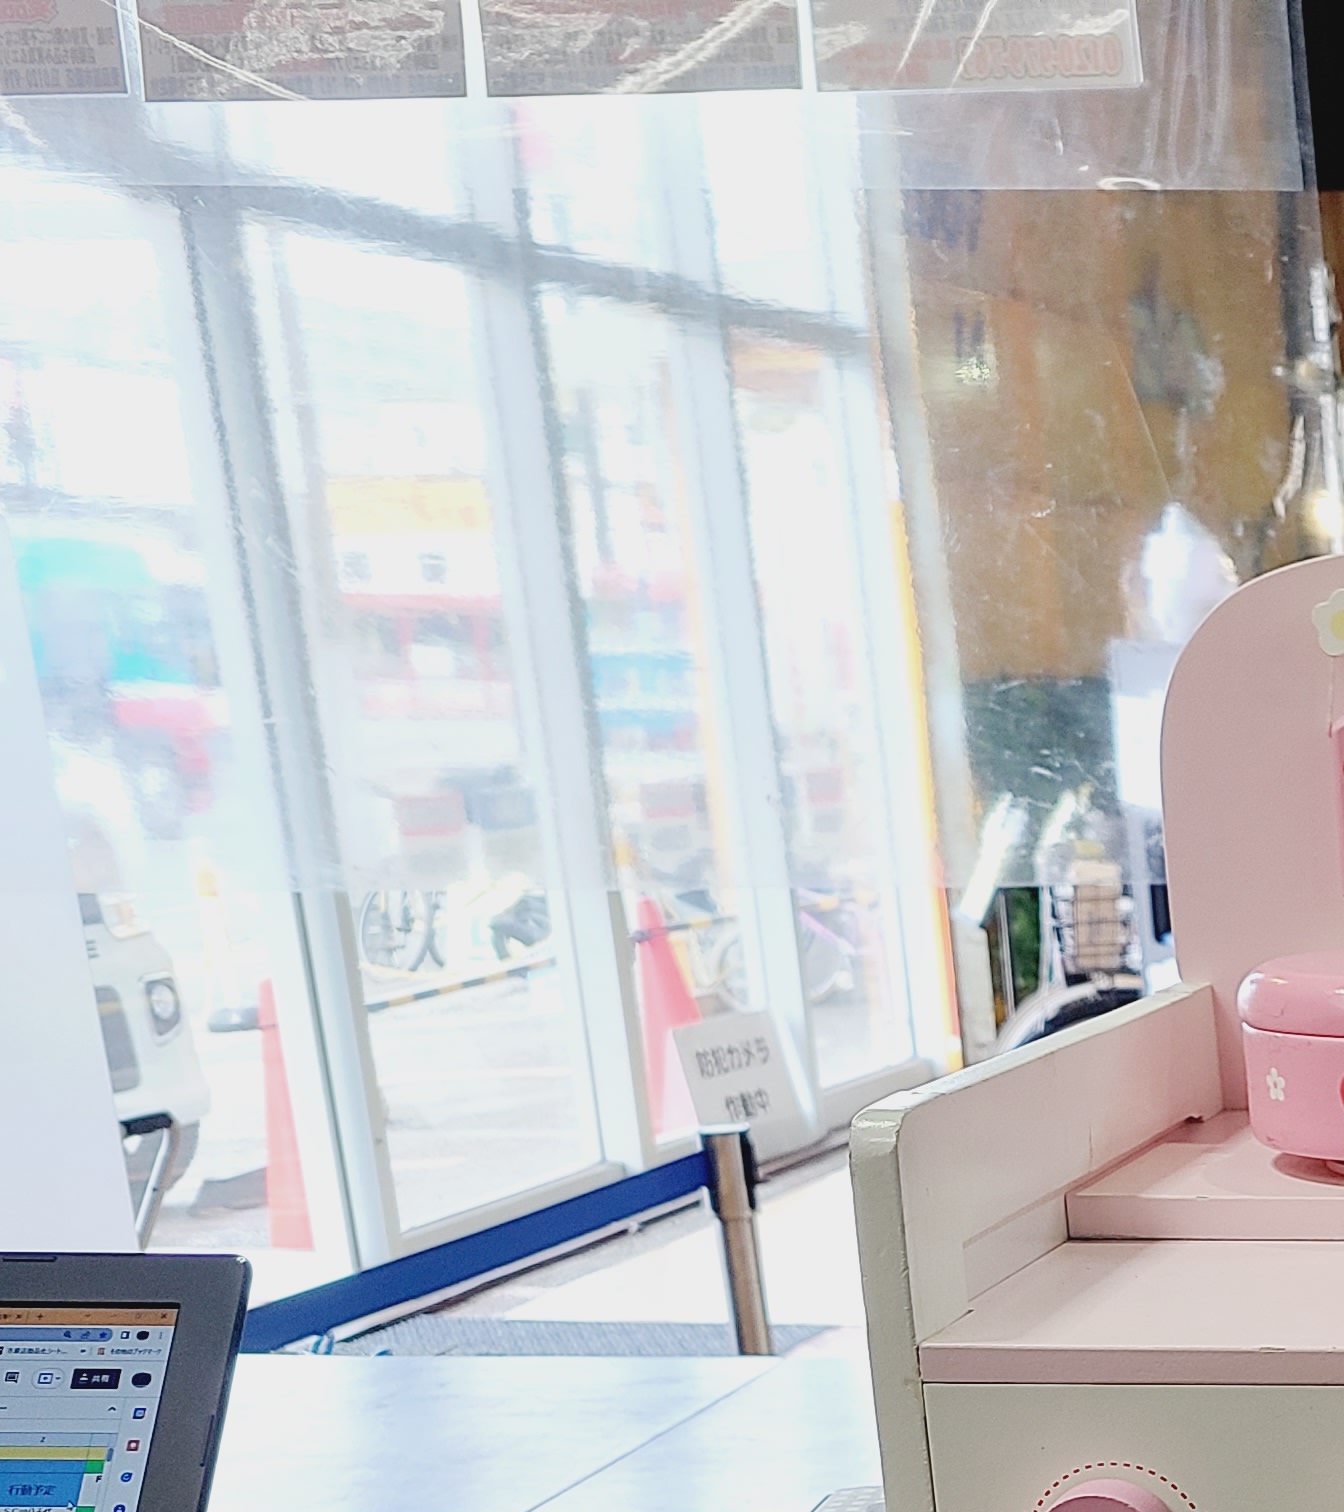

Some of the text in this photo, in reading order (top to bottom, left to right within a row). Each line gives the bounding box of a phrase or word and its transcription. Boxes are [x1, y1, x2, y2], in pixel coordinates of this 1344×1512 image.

[695, 1037, 770, 1078] 防犯カメラ
